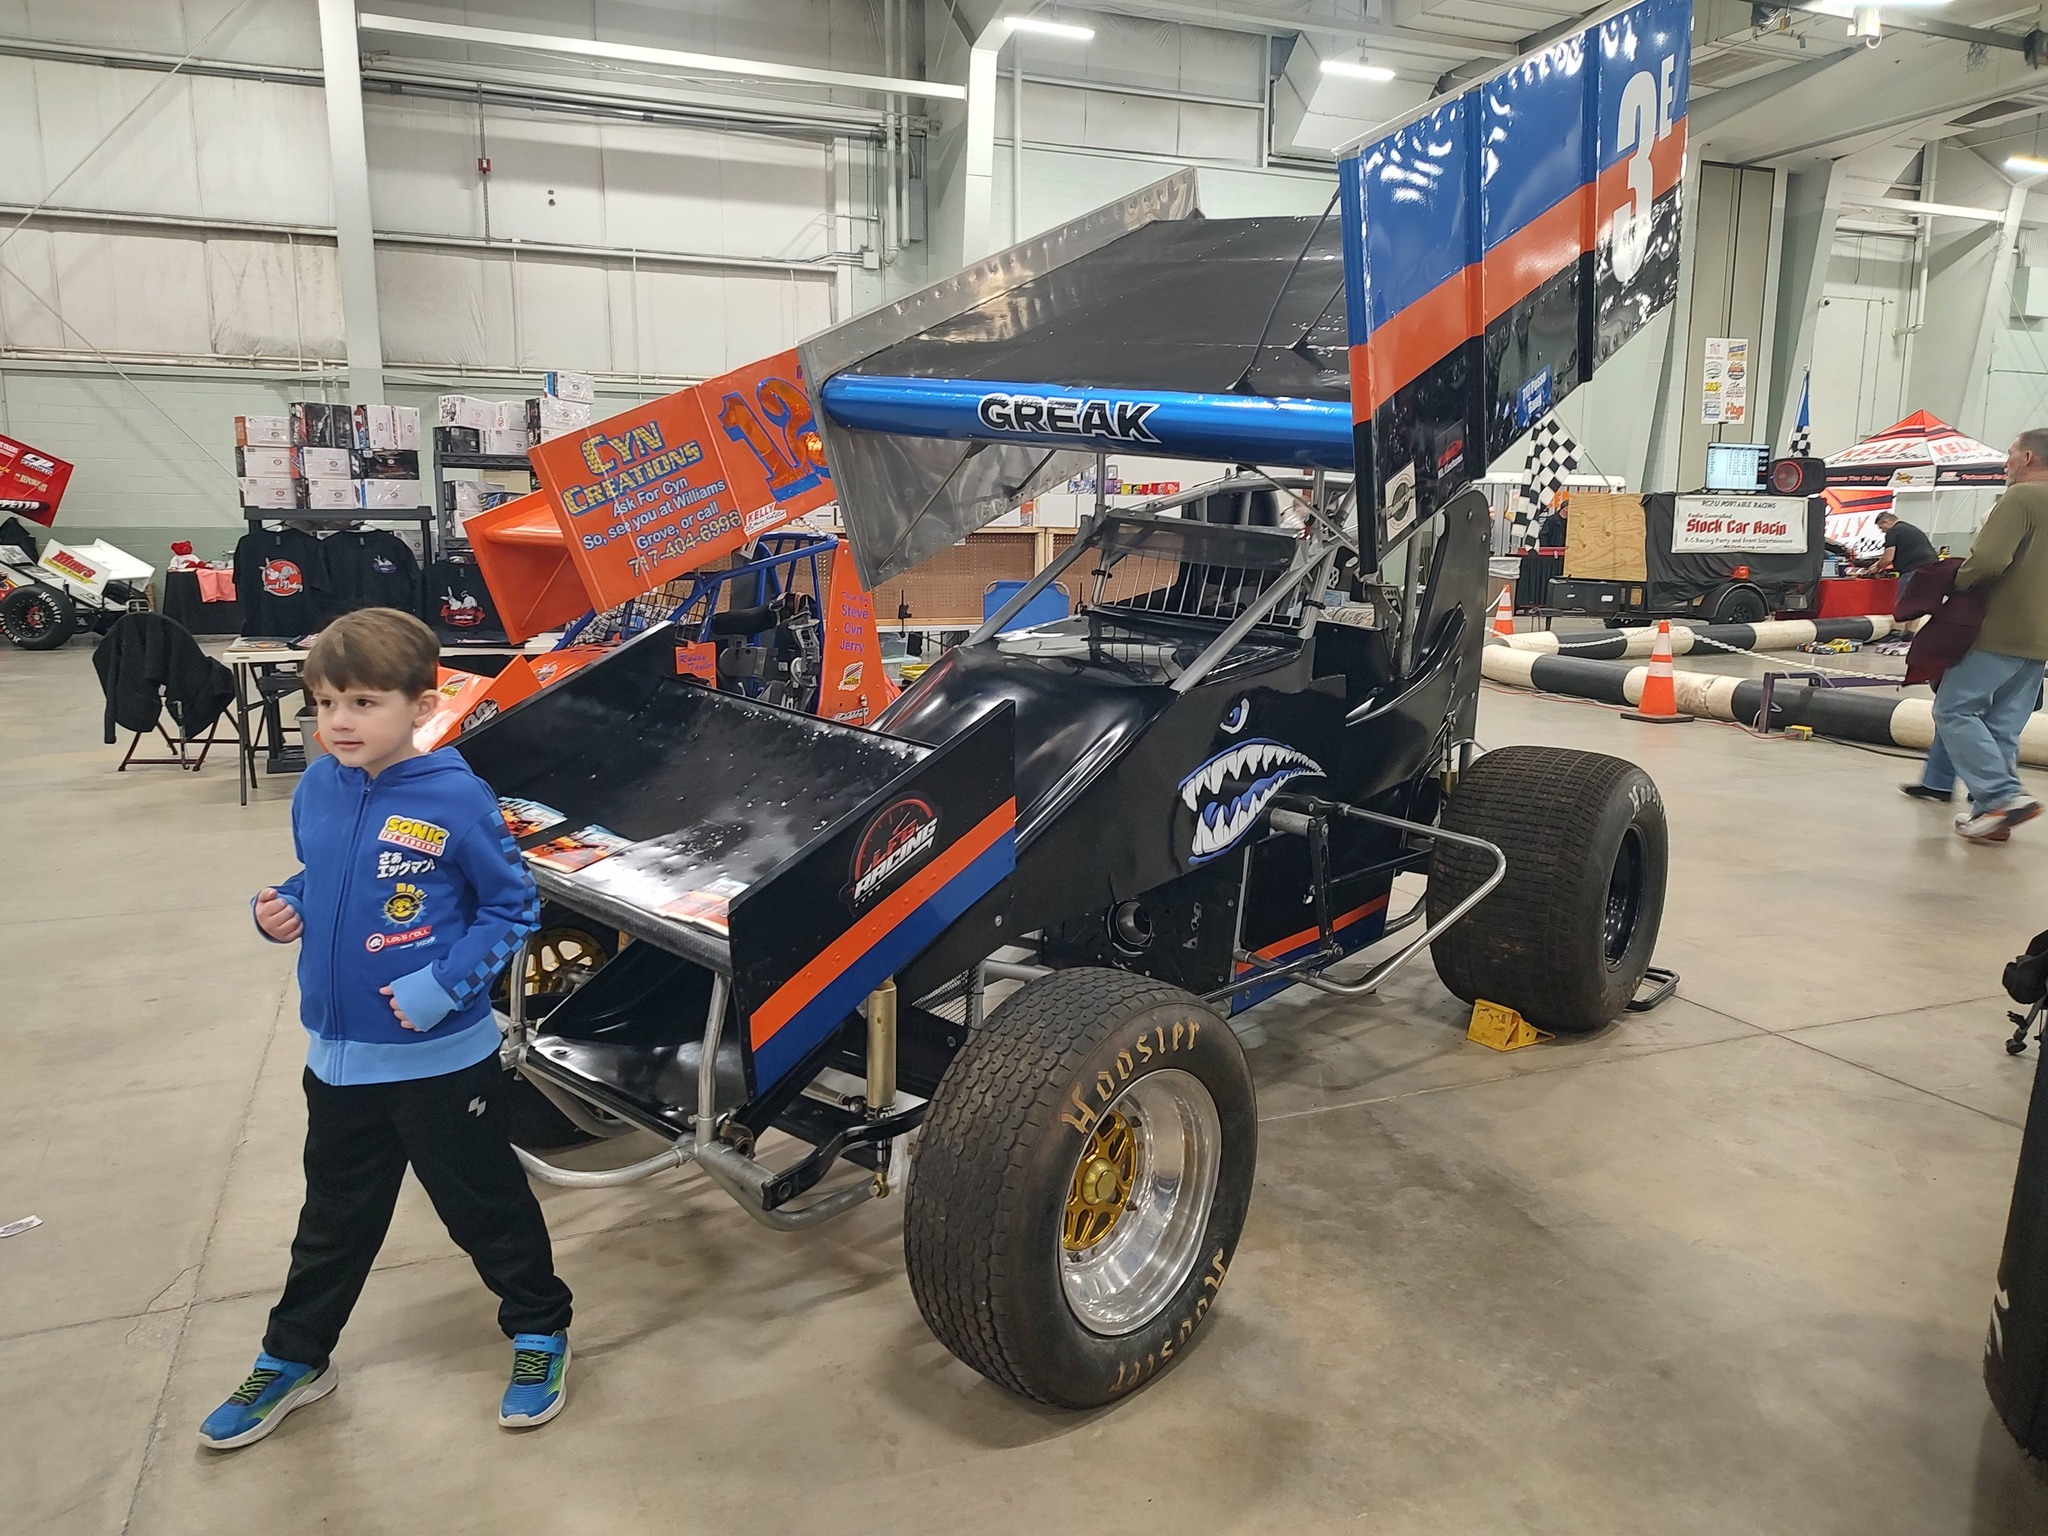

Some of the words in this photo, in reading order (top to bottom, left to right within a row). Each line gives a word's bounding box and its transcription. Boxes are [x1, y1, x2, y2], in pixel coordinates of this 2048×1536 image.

[978, 393, 1161, 443] GREAK
[1842, 442, 1920, 459] KELLY
[612, 494, 637, 518] Ask
[636, 486, 660, 507] For
[662, 476, 689, 496] Cyn
[1720, 500, 1751, 508] PORTABLE
[1753, 501, 1777, 509] RACING
[582, 533, 608, 550] So,
[608, 520, 632, 539] see
[631, 512, 658, 532] you
[660, 500, 674, 517] at
[672, 480, 727, 510] Williams
[635, 525, 681, 550] Grove,
[680, 513, 695, 530] or
[696, 500, 720, 522] call
[747, 503, 776, 525] KELLY
[1686, 518, 1723, 534] Stock
[1726, 519, 1751, 535] Car
[627, 510, 743, 578] 717-404-6996
[841, 604, 869, 619] Steve
[839, 639, 865, 655] Jerry
[387, 817, 447, 846] SONIC
[378, 850, 403, 865] さあ
[853, 817, 938, 900] RACING
